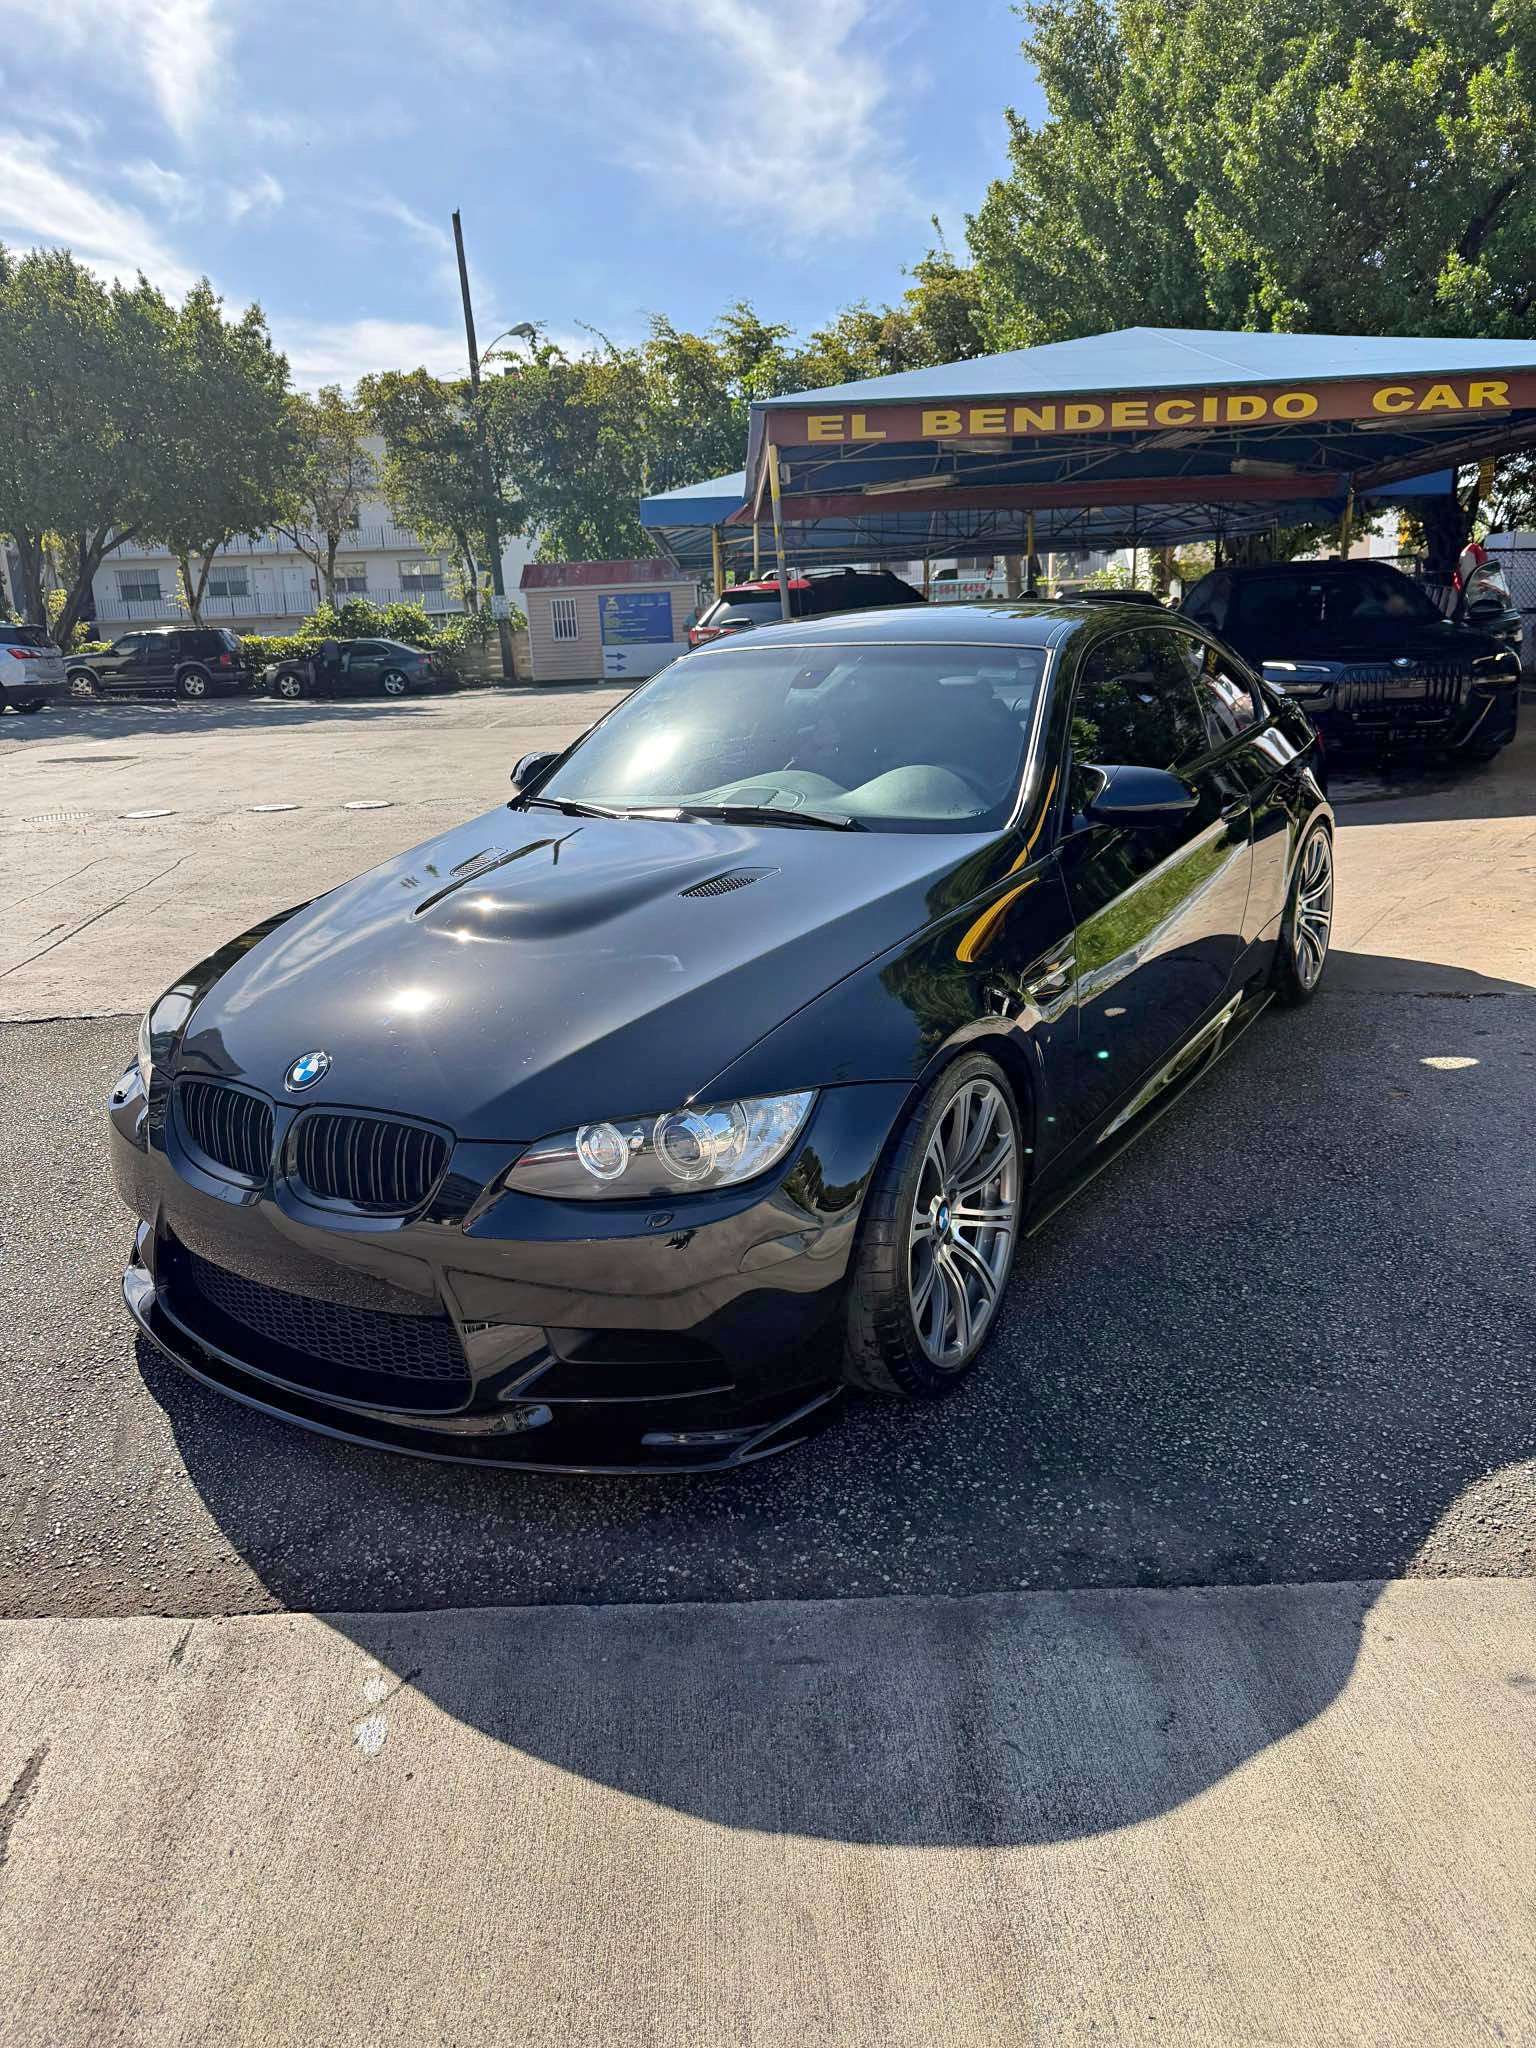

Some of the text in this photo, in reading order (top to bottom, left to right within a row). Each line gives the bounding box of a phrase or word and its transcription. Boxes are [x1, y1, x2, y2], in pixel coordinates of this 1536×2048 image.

[807, 381, 1511, 441] EL BENDECIDO CAR
